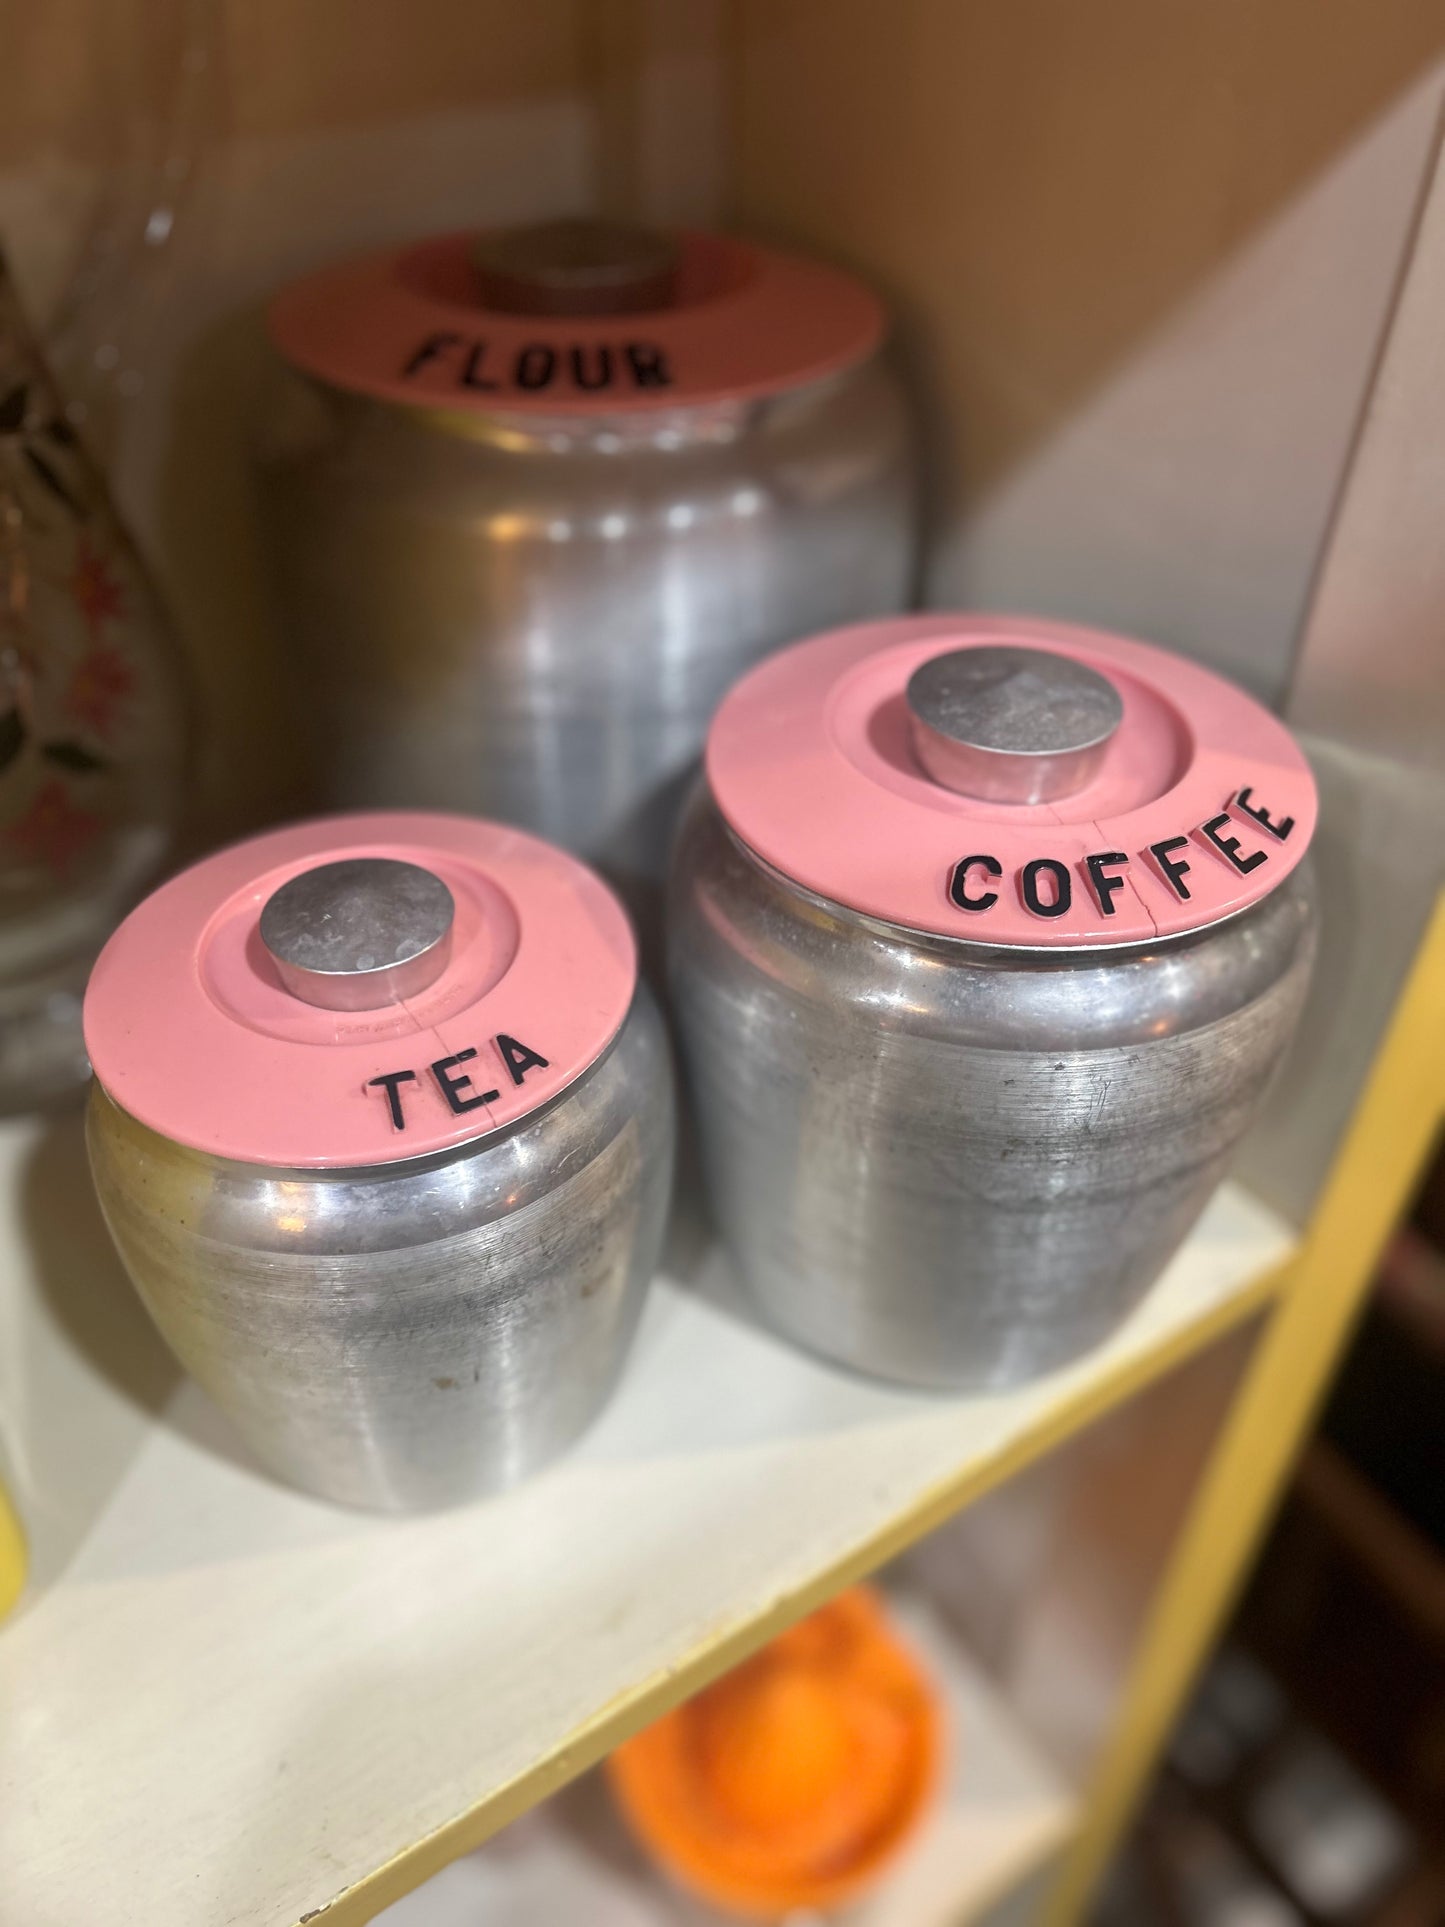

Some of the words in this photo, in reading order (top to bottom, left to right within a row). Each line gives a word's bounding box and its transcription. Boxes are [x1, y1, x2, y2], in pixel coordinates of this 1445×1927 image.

[401, 333, 672, 392] FLOUR
[949, 785, 1295, 919] COFFEE
[367, 1033, 550, 1131] TEA
